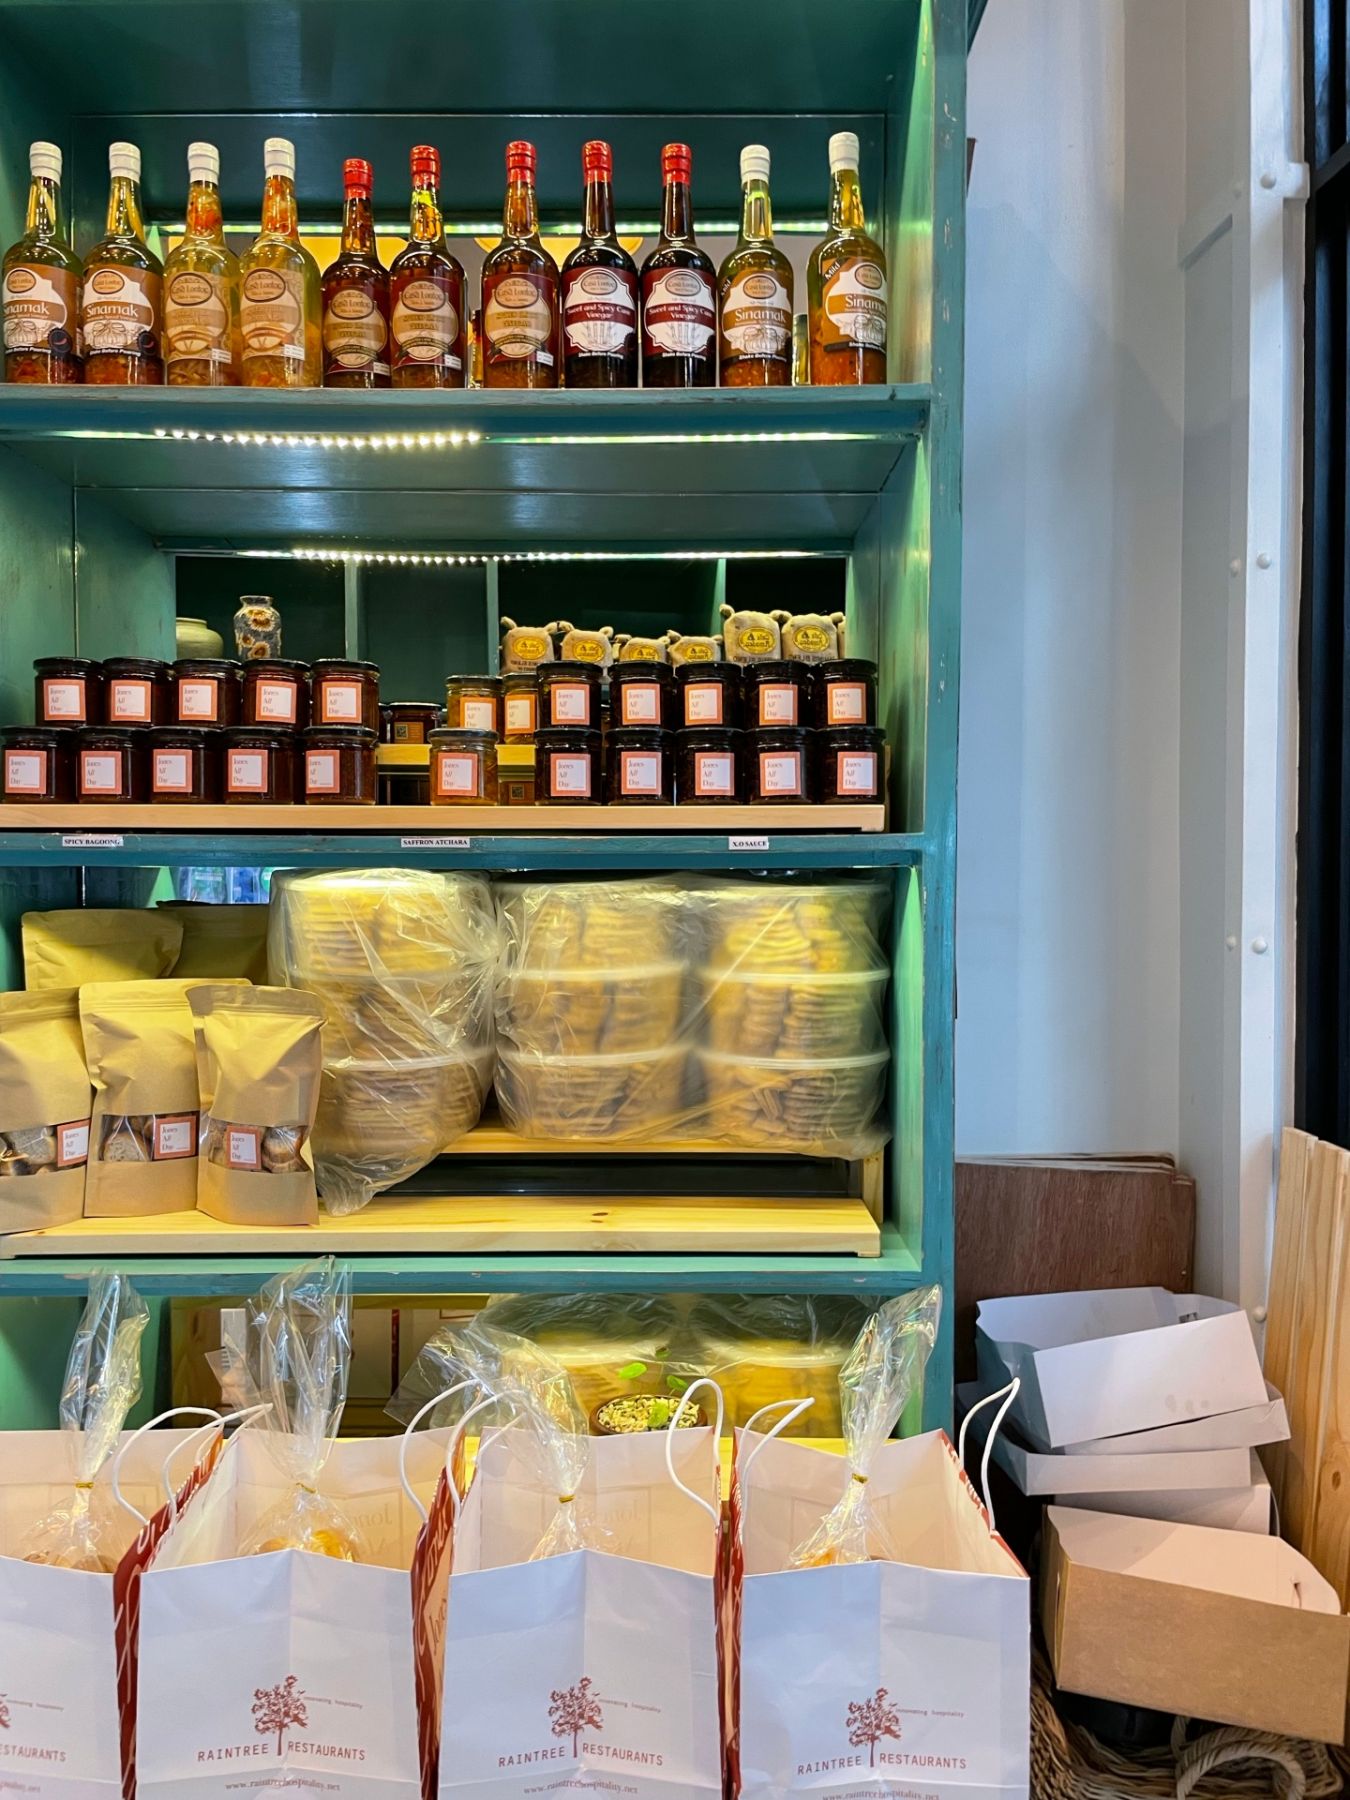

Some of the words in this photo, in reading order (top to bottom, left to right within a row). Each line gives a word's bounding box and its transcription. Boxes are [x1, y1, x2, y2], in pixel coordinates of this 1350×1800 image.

[824, 260, 840, 280] Mild
[87, 304, 138, 317] Sinamak
[567, 306, 582, 314] Sweet
[598, 304, 615, 313] Spicy
[649, 305, 666, 314] Sweet
[682, 304, 699, 314] Spicy
[735, 308, 786, 323] Sinamak
[0, 1743, 66, 1762] STAURANTS
[197, 1743, 269, 1762] RAINTREE
[288, 1740, 366, 1761] RESTAURANTS
[498, 1746, 565, 1768] RAINTREE
[582, 1742, 664, 1766] RESTAURANTS
[797, 1755, 862, 1776] RAINTREE
[880, 1752, 967, 1769] RESTAURANTS
